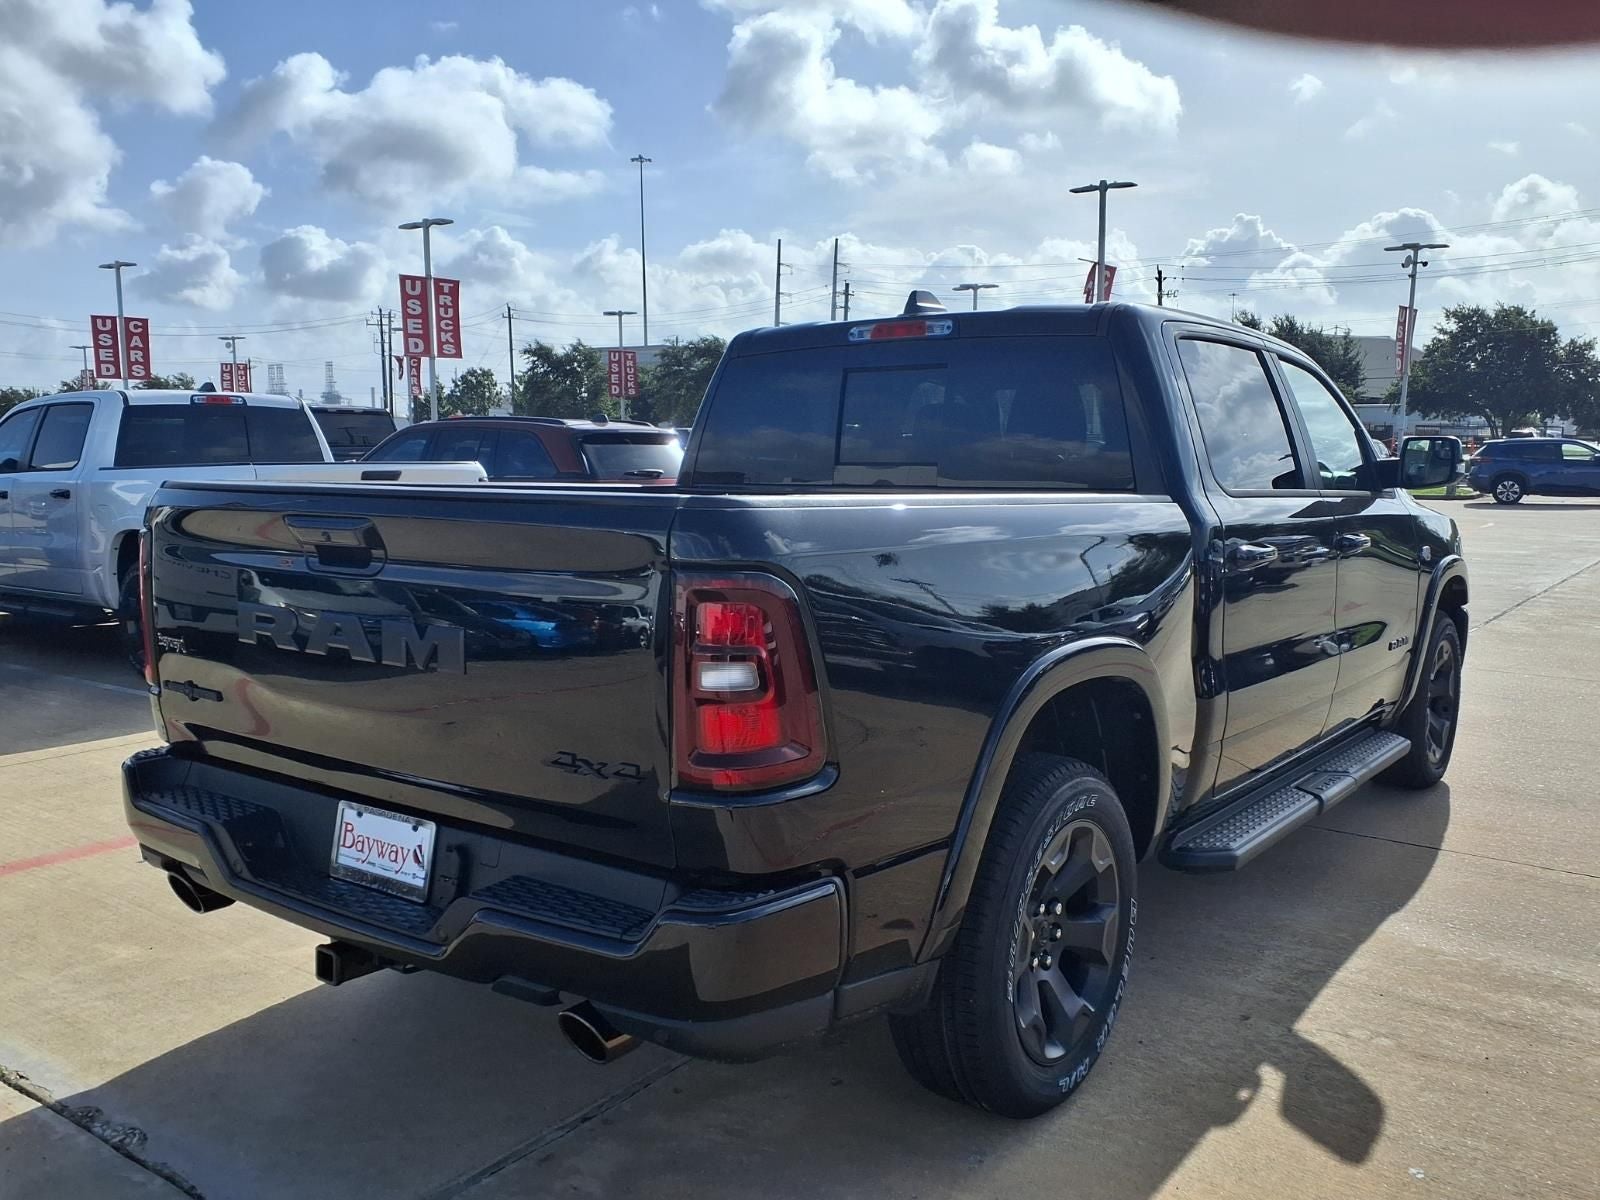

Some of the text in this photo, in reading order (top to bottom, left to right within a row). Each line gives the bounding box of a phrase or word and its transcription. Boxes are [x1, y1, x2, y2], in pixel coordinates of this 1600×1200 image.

[404, 279, 425, 354] USED
[438, 282, 457, 355] TRUCKS
[1396, 309, 1406, 371] USED
[96, 318, 116, 376] USED
[128, 320, 146, 377] CARS
[610, 351, 620, 395] USED
[626, 352, 636, 395] TRUCKS
[222, 363, 232, 392] USE
[237, 363, 247, 392] TRUCK
[410, 358, 420, 395] CARS
[238, 602, 467, 675] RAM
[341, 821, 411, 874] Bayway
